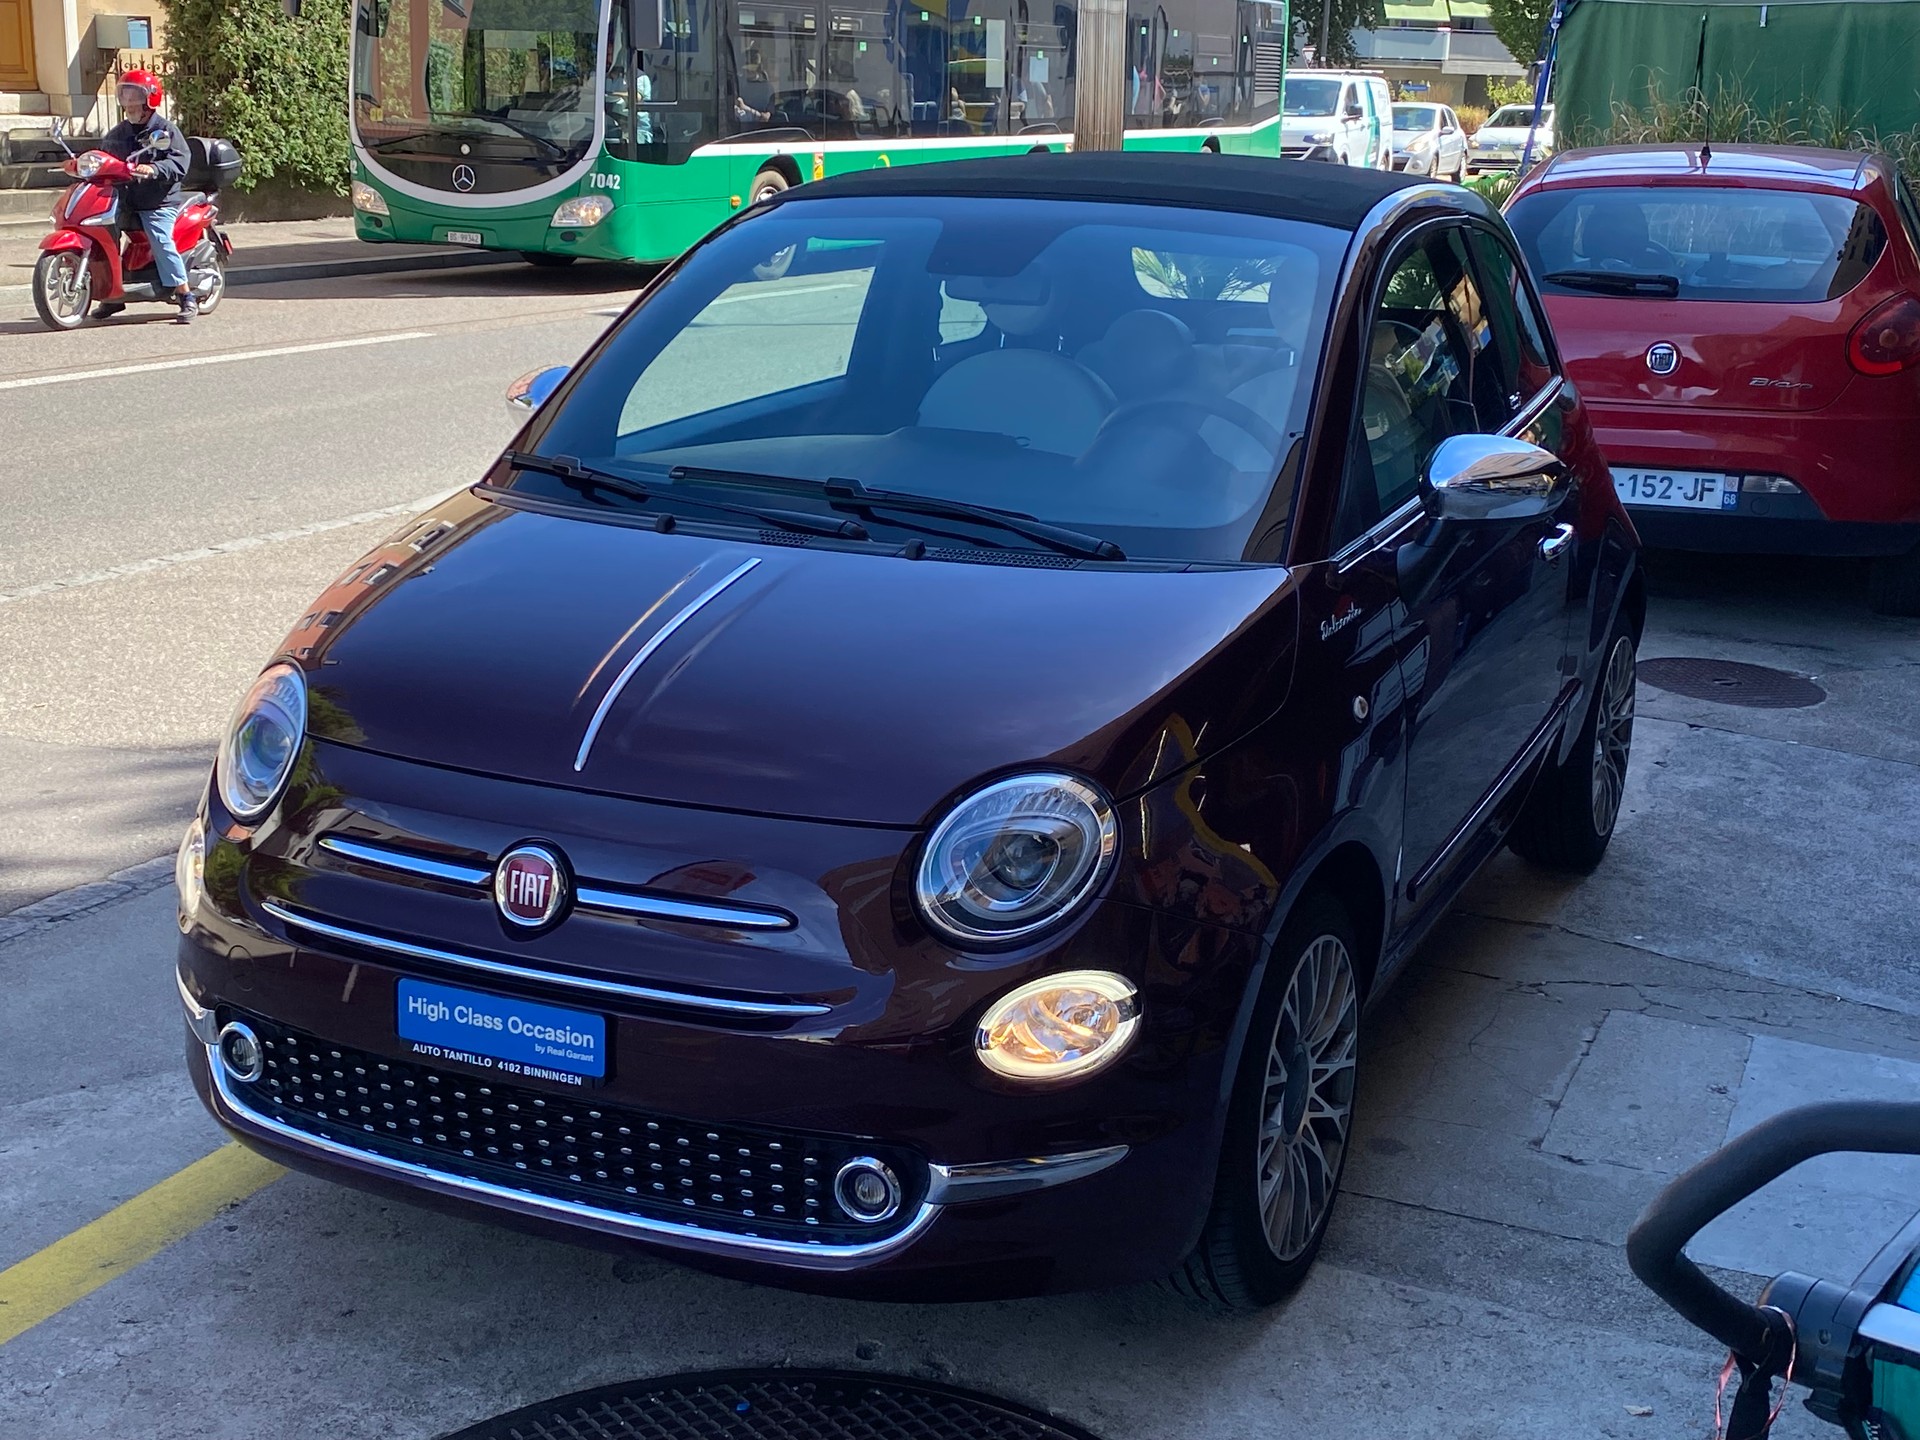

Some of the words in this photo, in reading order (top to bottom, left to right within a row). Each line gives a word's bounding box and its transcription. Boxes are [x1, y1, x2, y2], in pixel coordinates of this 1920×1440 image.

[590, 173, 621, 190] 7042
[1610, 473, 1717, 502] -152-JF
[1723, 493, 1737, 505] 68
[509, 869, 550, 908] FIAT
[408, 995, 450, 1022] High
[454, 1005, 504, 1031] Class
[507, 1015, 595, 1049] Occasion
[412, 1043, 441, 1057] AUTO
[443, 1048, 493, 1068] TANTILLO
[497, 1060, 521, 1074] 4102
[523, 1065, 583, 1086] BINNINGEN
[534, 1043, 546, 1055] by
[546, 1045, 565, 1057] Real
[566, 1049, 594, 1063] Garant
